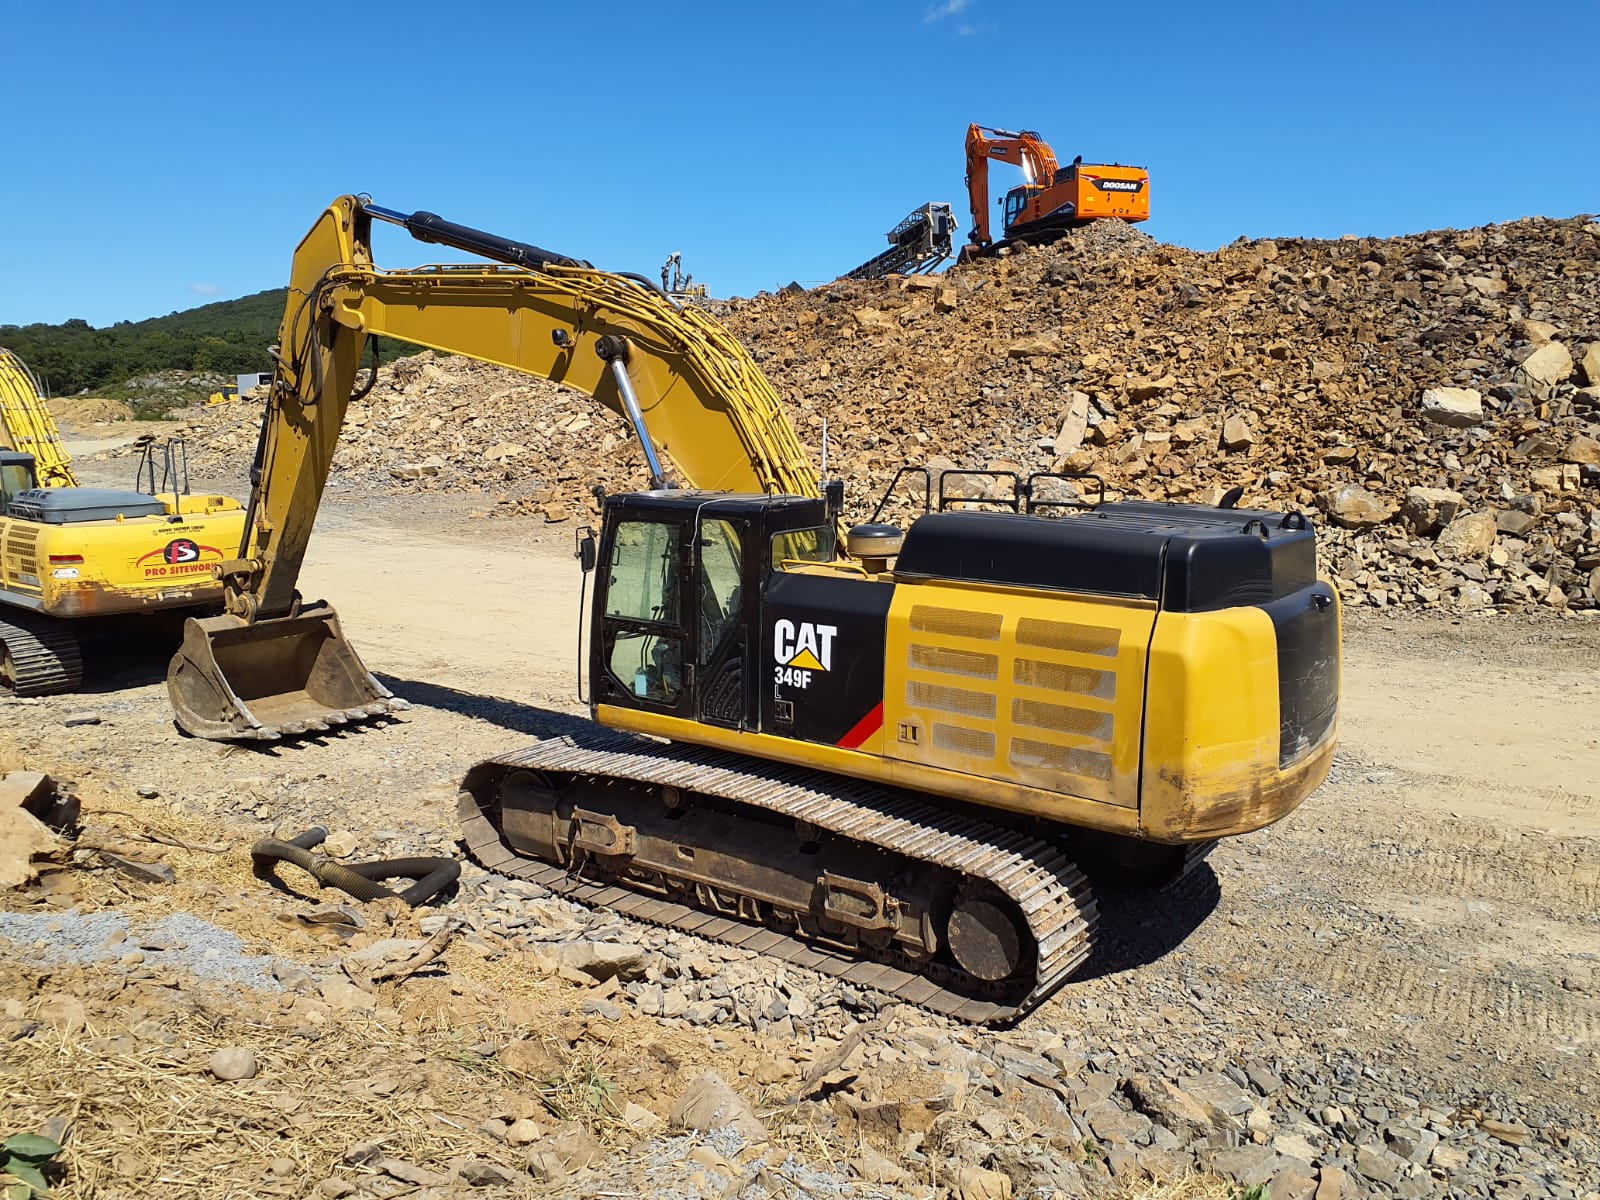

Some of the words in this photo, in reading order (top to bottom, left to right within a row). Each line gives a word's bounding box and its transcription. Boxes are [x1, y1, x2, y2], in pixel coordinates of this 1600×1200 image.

[1102, 181, 1137, 190] DOOSAN
[145, 567, 167, 577] PRO
[774, 619, 838, 672] CAT
[774, 666, 812, 689] 349F
